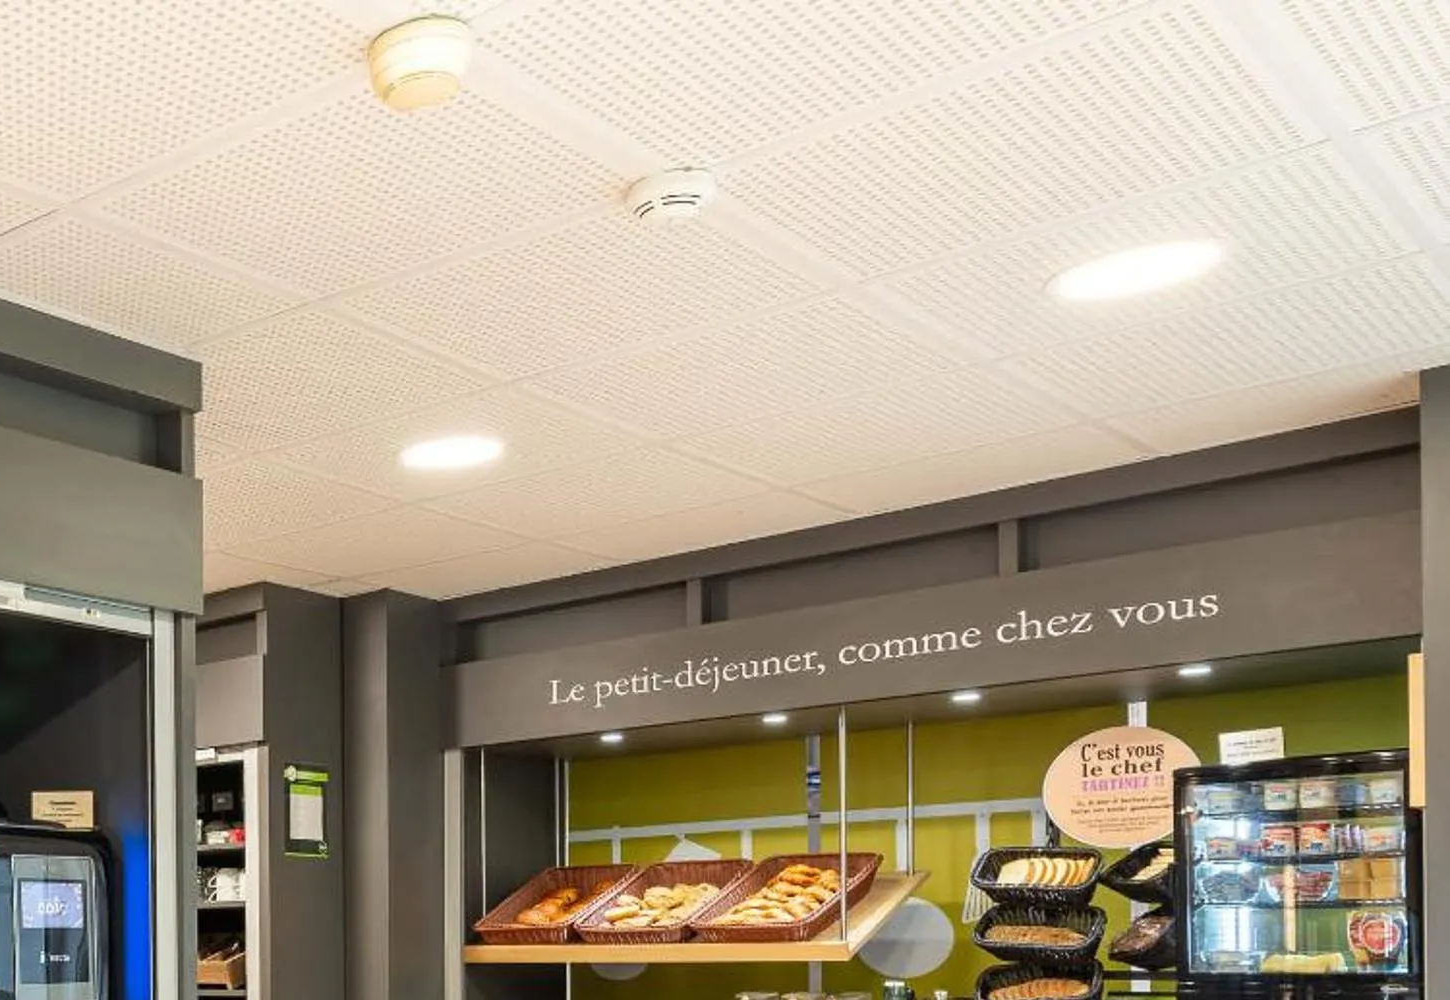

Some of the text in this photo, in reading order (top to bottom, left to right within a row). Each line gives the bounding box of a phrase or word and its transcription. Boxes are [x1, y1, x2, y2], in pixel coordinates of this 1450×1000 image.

[549, 593, 1221, 709] Le petit-déjeuner, comme chez vous
[1080, 743, 1165, 762] C'est vous
[1081, 758, 1163, 778] le chef
